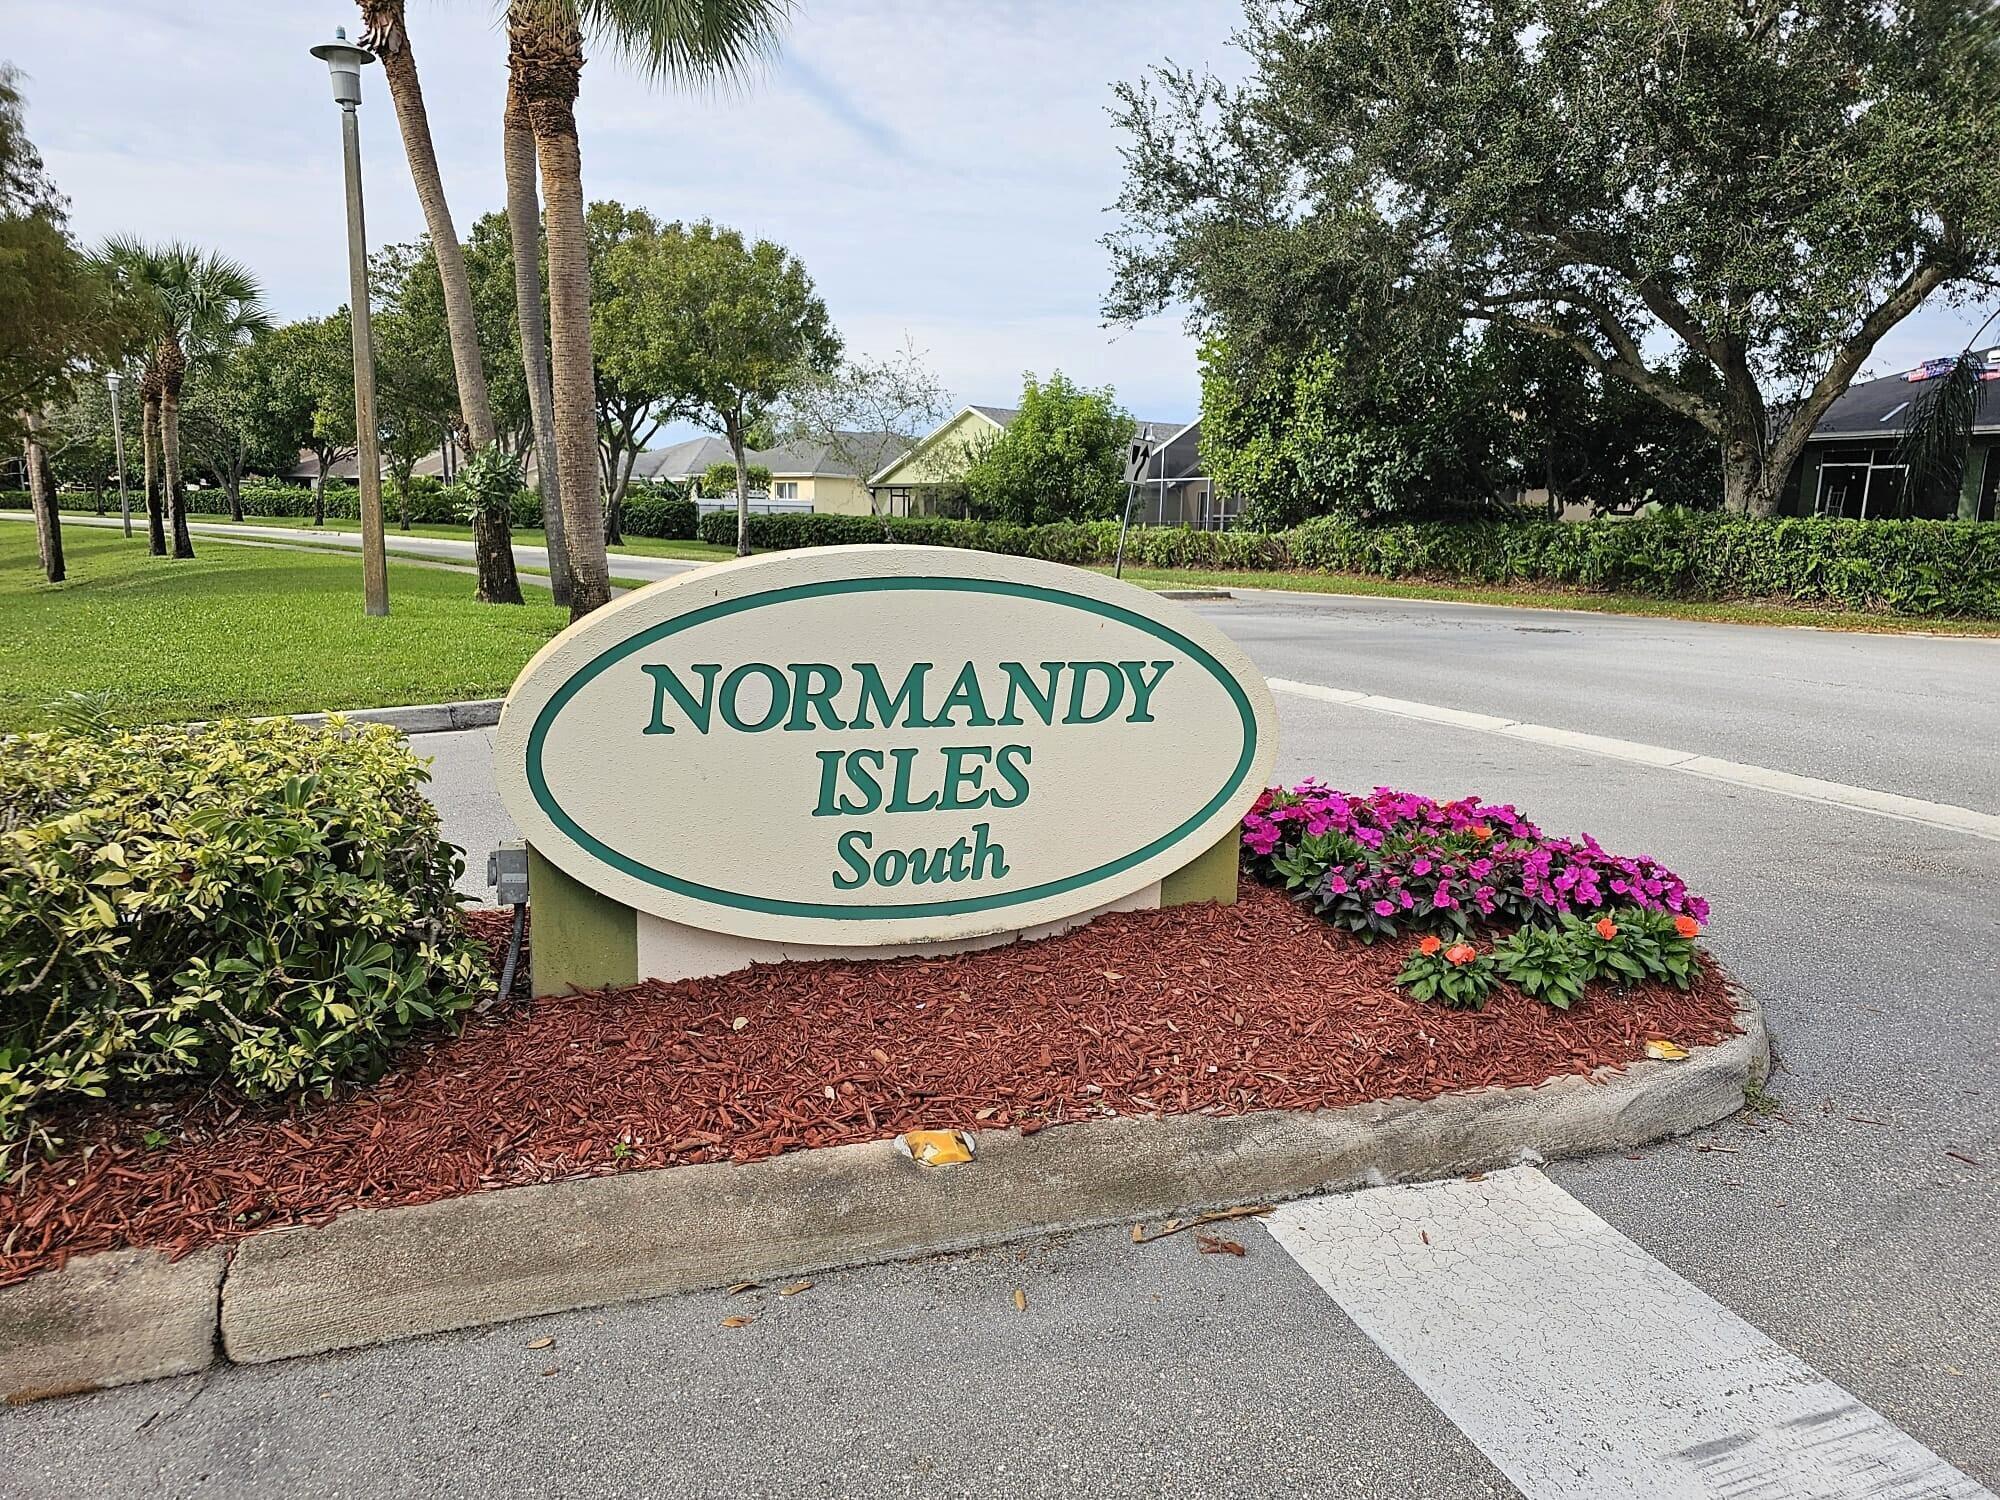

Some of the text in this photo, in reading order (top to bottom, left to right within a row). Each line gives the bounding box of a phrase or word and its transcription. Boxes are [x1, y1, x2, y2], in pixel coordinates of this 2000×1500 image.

[641, 660, 1174, 735] NORMANDY
[811, 744, 1032, 817] ISLES
[832, 823, 1009, 890] South
